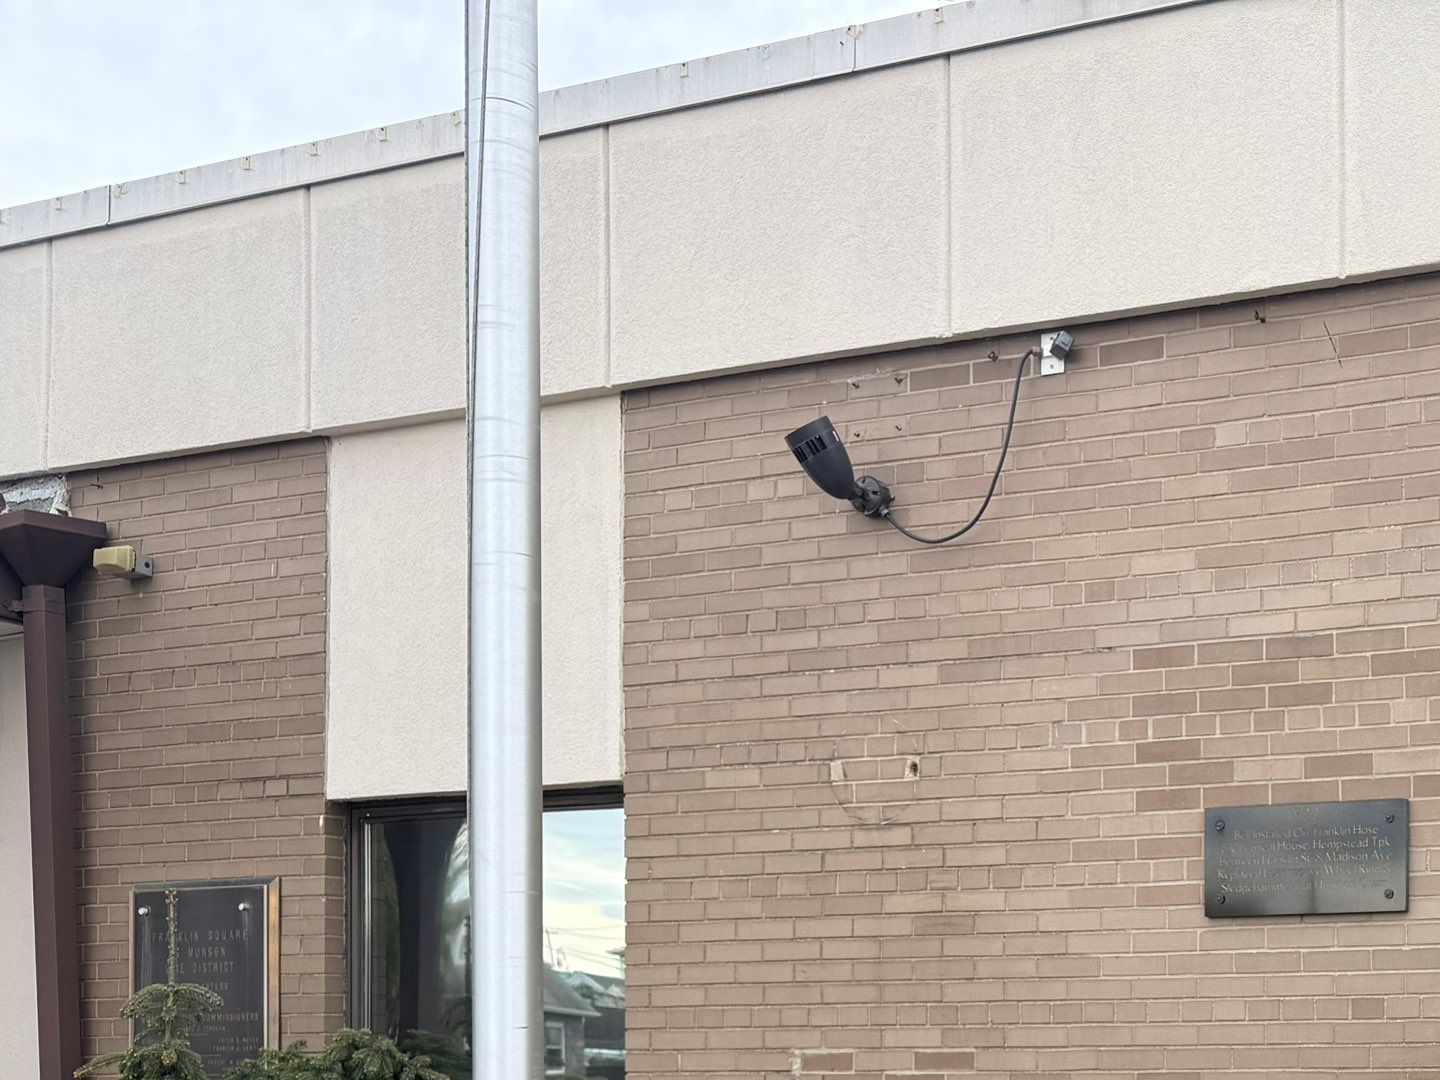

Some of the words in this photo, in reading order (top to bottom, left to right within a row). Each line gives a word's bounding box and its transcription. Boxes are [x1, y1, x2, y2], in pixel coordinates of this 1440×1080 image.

[1353, 825, 1379, 836] Hose
[1313, 837, 1369, 851] Hempstead
[1325, 851, 1368, 862] Madison
[208, 928, 249, 942] SQUARE
[188, 946, 226, 959] MUNSON
[192, 961, 235, 974] DISTRICT
